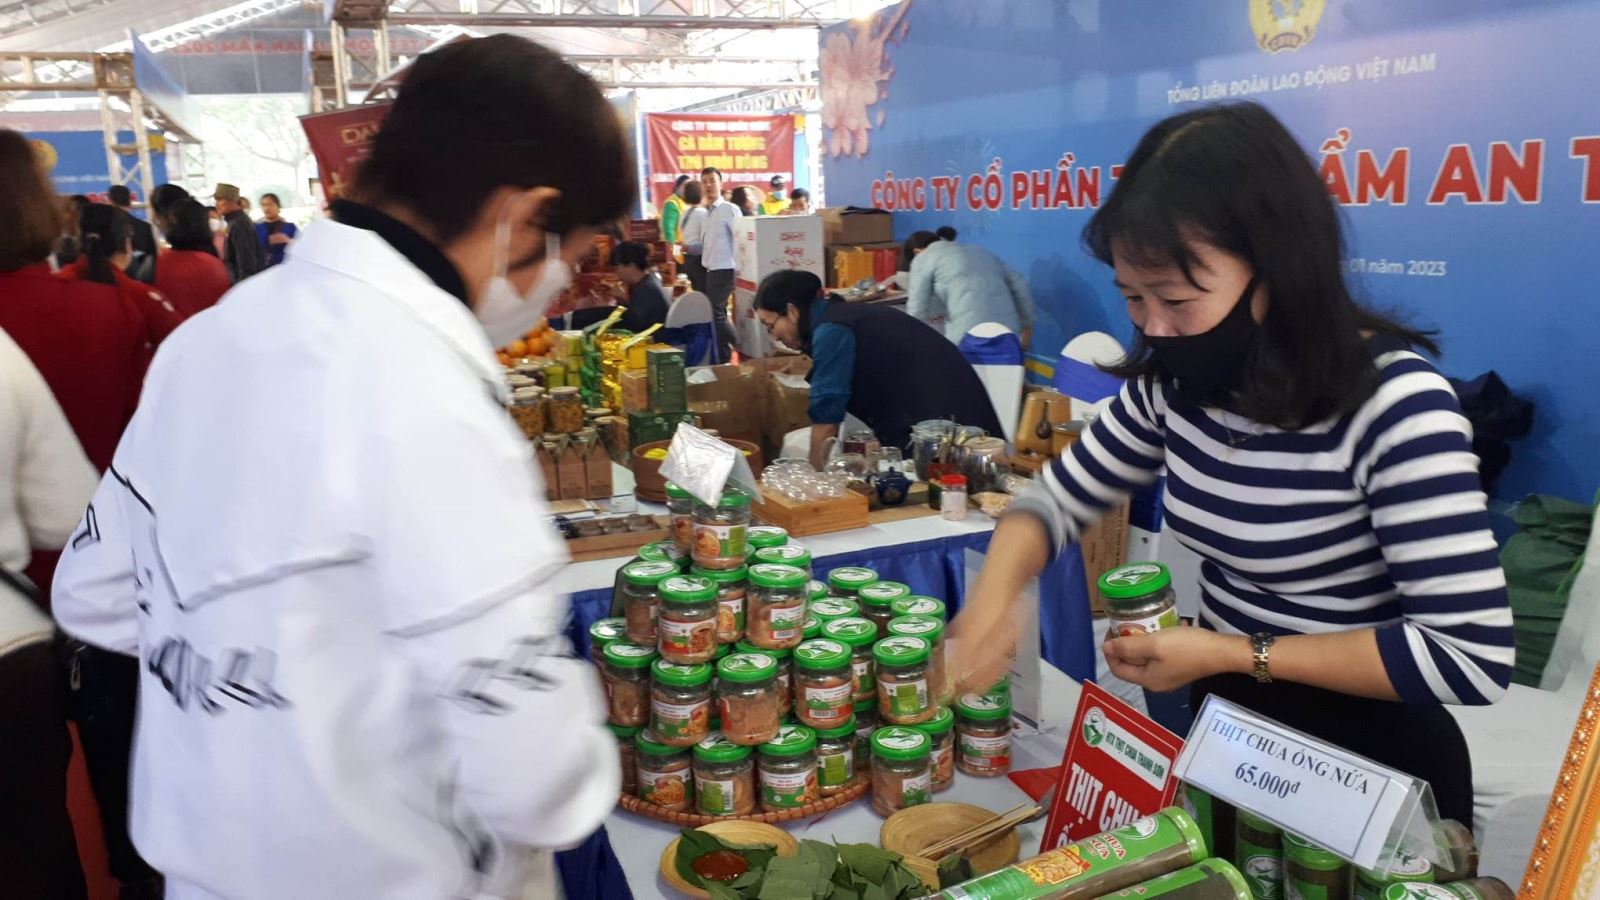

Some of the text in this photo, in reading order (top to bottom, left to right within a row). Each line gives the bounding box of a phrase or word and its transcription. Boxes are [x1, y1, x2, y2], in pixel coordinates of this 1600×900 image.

[1168, 52, 1437, 103] TỔNG LIÊN ĐOÀN LAO ĐỘNG VIỆT NAM
[870, 170, 926, 212] CÔNG
[930, 174, 961, 211] TY
[967, 156, 1003, 211] CỔ
[1318, 127, 1410, 206] ẨM
[1426, 139, 1544, 204] AN
[1569, 136, 1600, 203] T
[1369, 258, 1405, 274] năm
[1406, 260, 1447, 276] 2023
[1211, 718, 1368, 795] THỊT CHUA ỐNG NỨA
[1065, 761, 1145, 831] THỊT CHU
